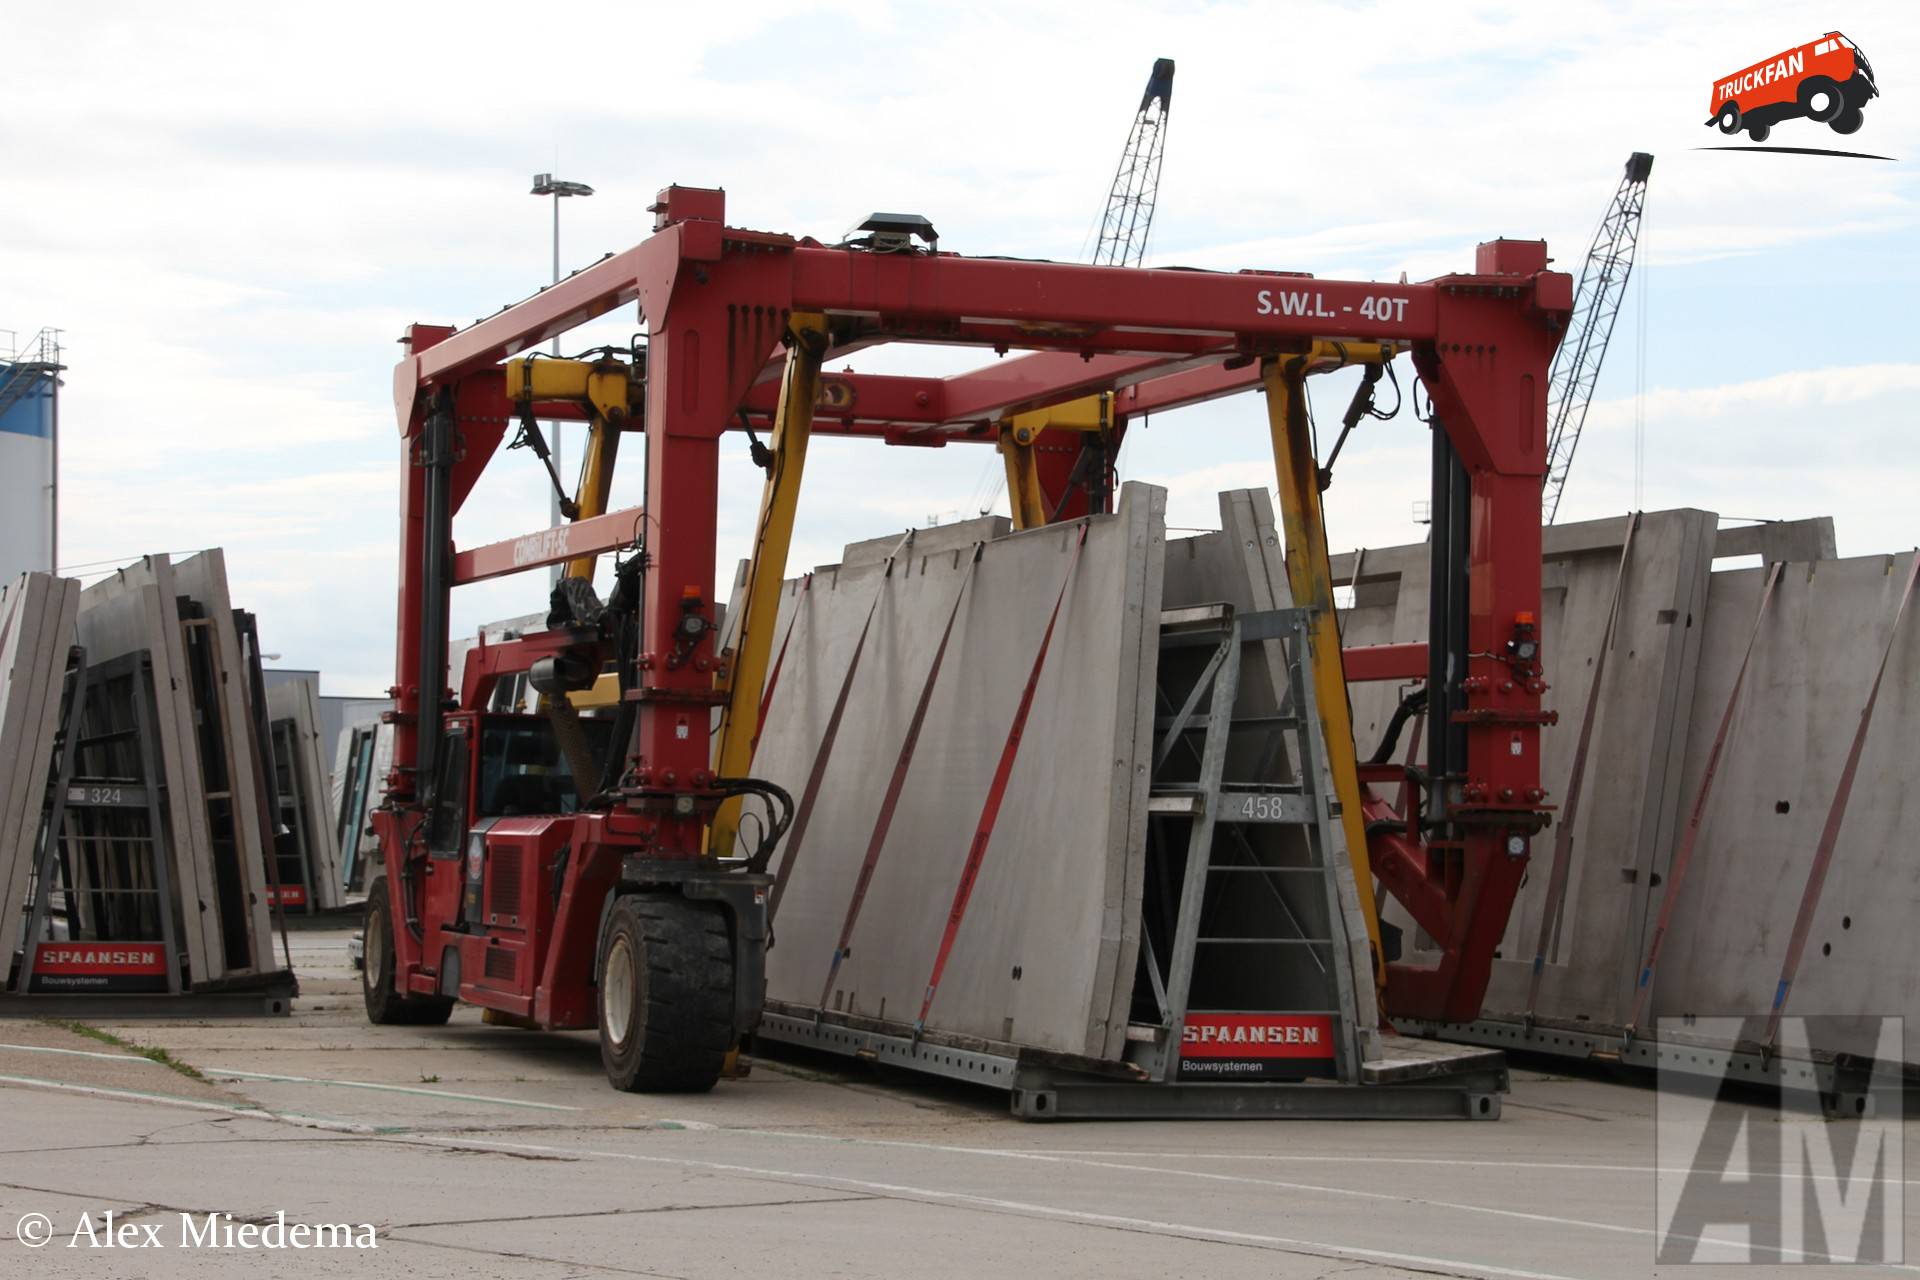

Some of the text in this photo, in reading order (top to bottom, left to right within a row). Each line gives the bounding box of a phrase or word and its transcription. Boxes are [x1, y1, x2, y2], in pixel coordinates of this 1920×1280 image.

[1257, 290, 1335, 318] S.W.L.
[1360, 296, 1409, 322] 40T
[91, 787, 121, 804] 324
[1242, 797, 1282, 819] 458
[43, 951, 155, 965] SPAANSEN
[42, 976, 108, 986] Bouwsystemen
[1183, 1025, 1319, 1045] SPAANSEN
[1182, 1060, 1263, 1073] Bouwsystemen
